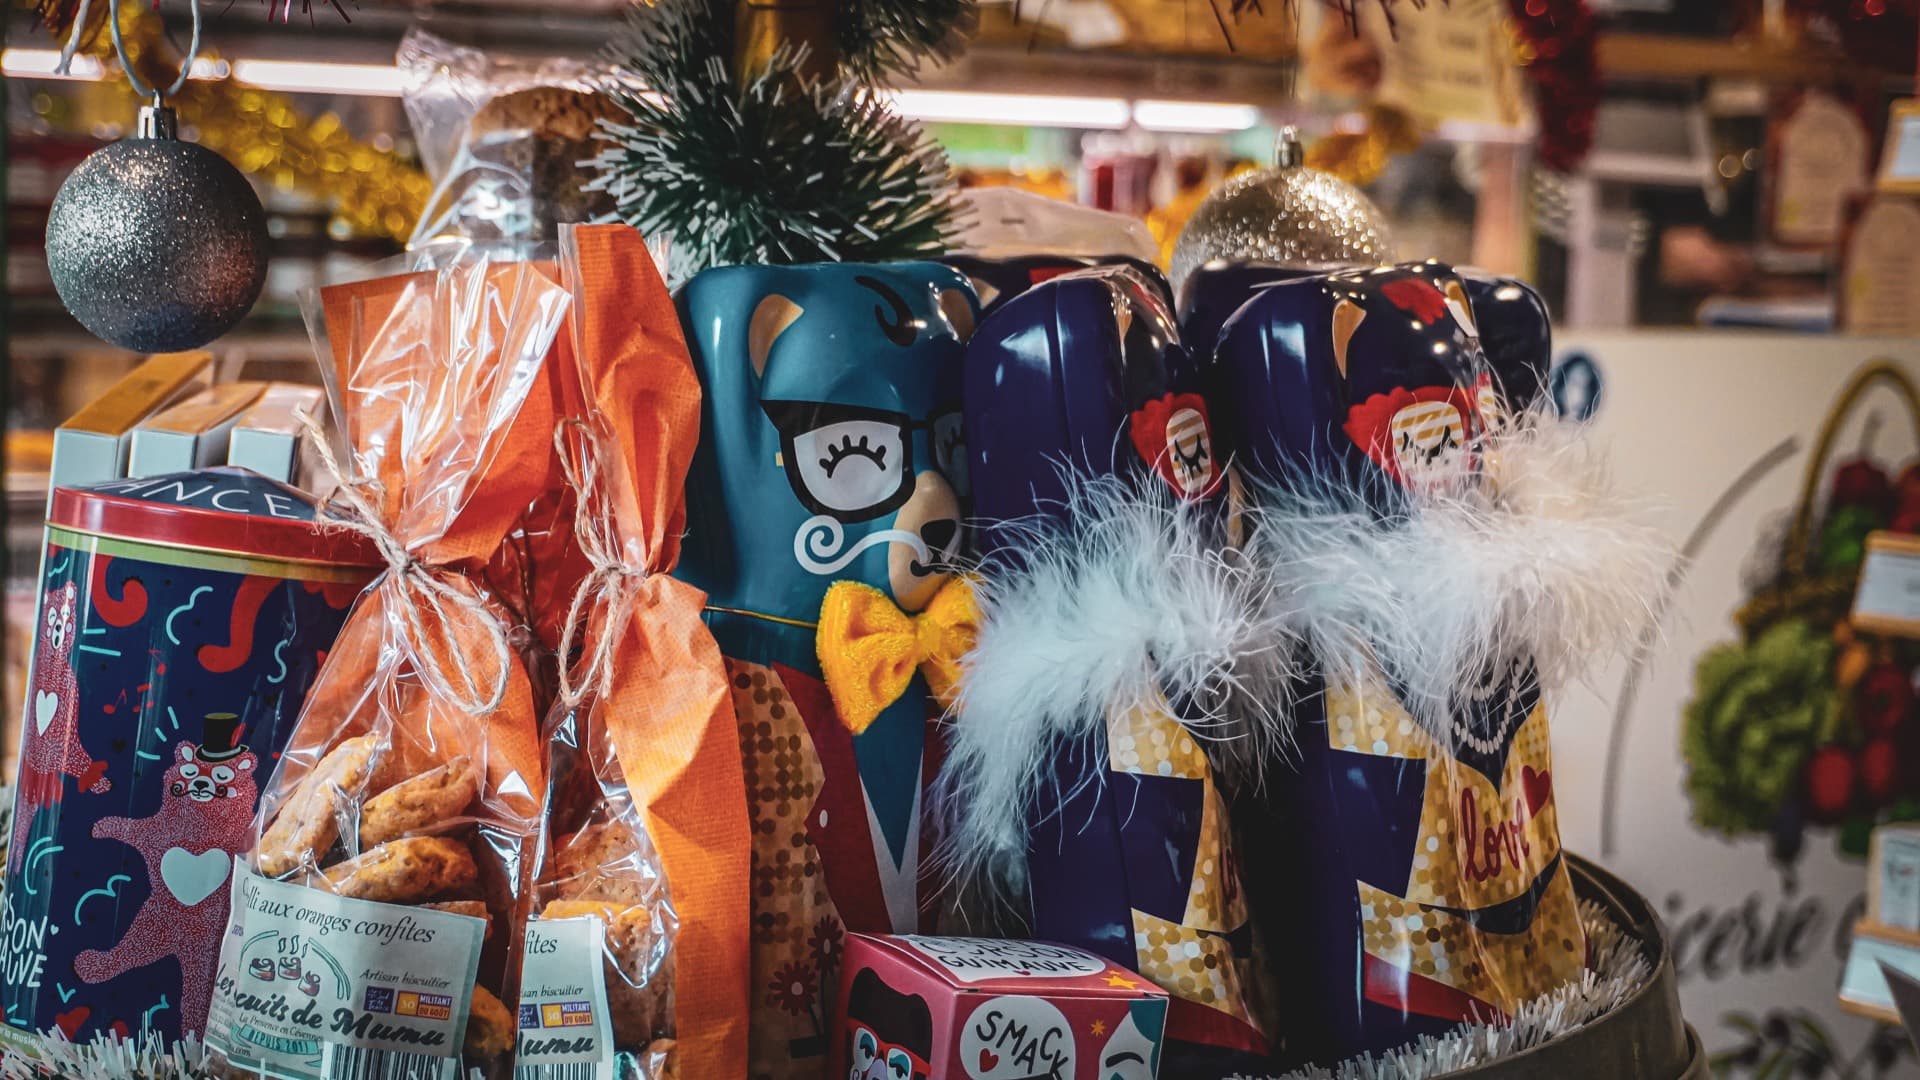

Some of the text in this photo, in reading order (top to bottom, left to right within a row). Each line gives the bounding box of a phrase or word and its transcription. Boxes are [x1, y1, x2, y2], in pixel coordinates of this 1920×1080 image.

[1461, 787, 1530, 882] love
[258, 900, 294, 918] aux
[295, 906, 351, 936] oranges
[354, 915, 436, 946] confites
[359, 969, 399, 984] Artisan
[938, 955, 1093, 972] GUIMAUVE
[420, 994, 451, 1006] MILITANT
[562, 1003, 590, 1012] MILITANT
[234, 989, 289, 1021] cuits
[291, 998, 323, 1028] de
[330, 1007, 445, 1046] Mumu
[976, 1010, 1069, 1080] SMACK
